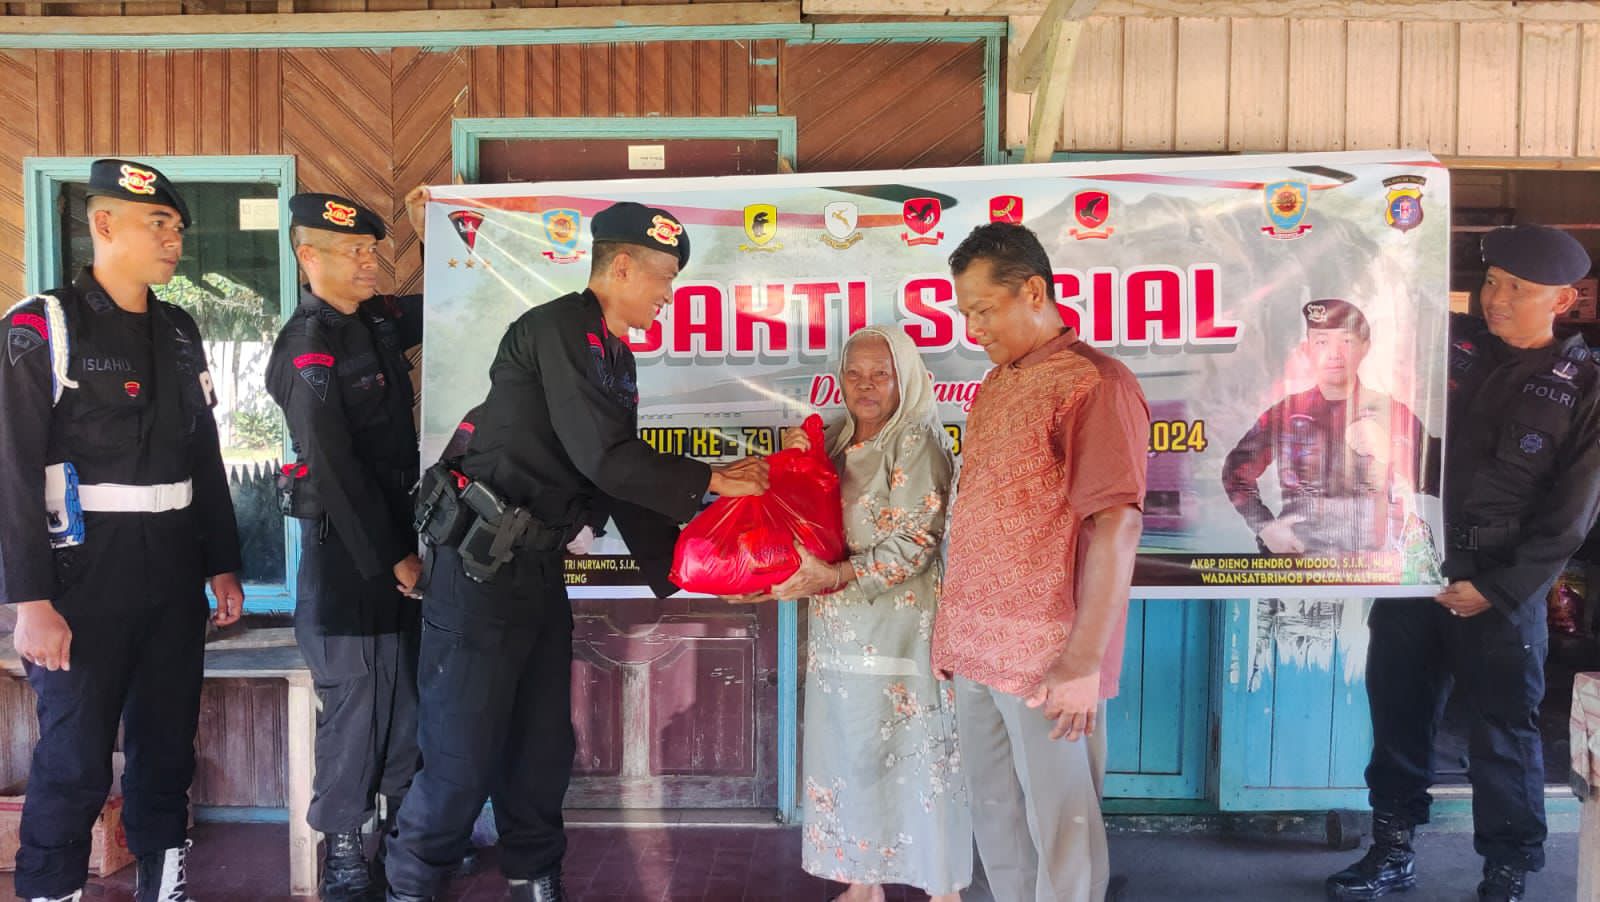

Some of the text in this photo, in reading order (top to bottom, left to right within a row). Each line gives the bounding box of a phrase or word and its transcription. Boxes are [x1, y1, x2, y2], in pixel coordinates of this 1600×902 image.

[900, 266, 1240, 348] SSIAL
[1523, 383, 1577, 408] POLRI
[640, 426, 688, 457] HUT
[691, 426, 722, 457] KE
[743, 426, 775, 457] 79
[1148, 420, 1208, 452] 024
[577, 559, 618, 572] NURYANTO,
[1190, 558, 1216, 569] AKBP
[1218, 558, 1249, 569] DIENO
[1251, 558, 1293, 569] HENDRO
[1201, 572, 1304, 584] WADANSATBRIMOB
[1305, 572, 1343, 584] POLDA
